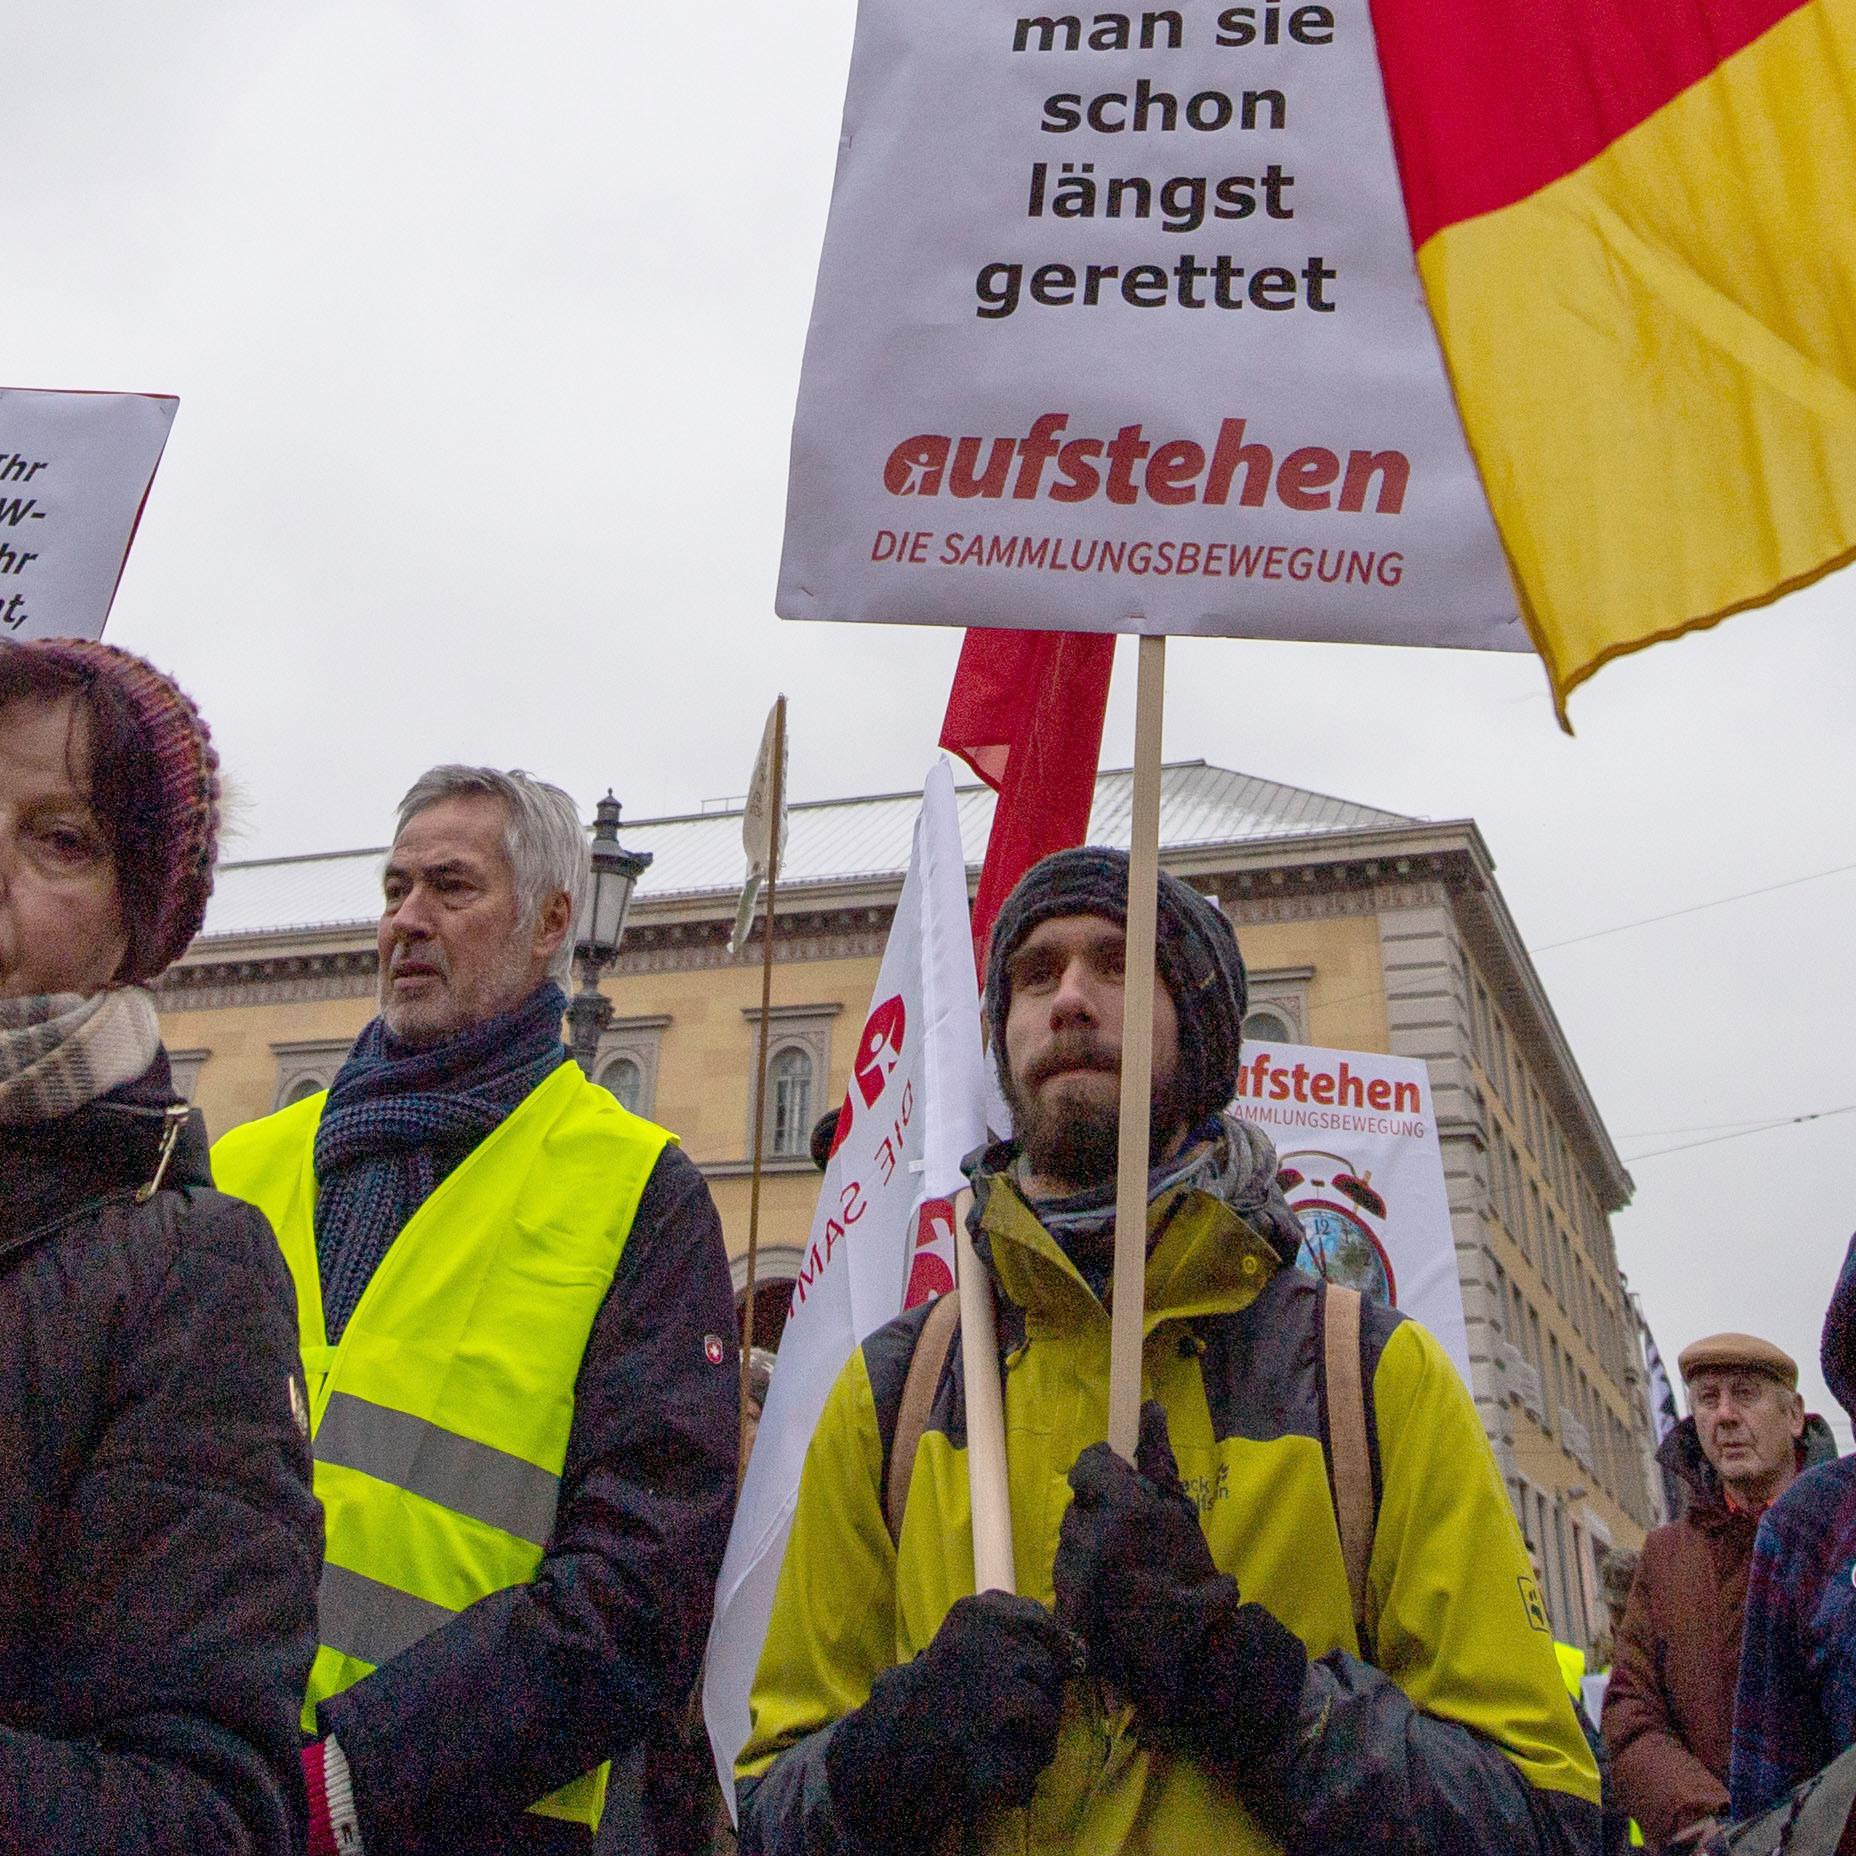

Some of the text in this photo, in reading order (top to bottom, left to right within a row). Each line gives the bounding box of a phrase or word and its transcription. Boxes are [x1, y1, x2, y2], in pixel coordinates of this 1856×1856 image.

[1013, 10, 1182, 51] man
[1041, 79, 1285, 133] schon
[1028, 163, 1294, 232] längst
[976, 255, 1336, 318] gerettet
[884, 413, 1409, 513] aufstehen
[871, 530, 1403, 587] DIE SAMMLUNGSBEWEGUNG
[1238, 1054, 1421, 1114] fstehen
[1234, 1105, 1425, 1139] AMMLUNGSBEWEGUNG
